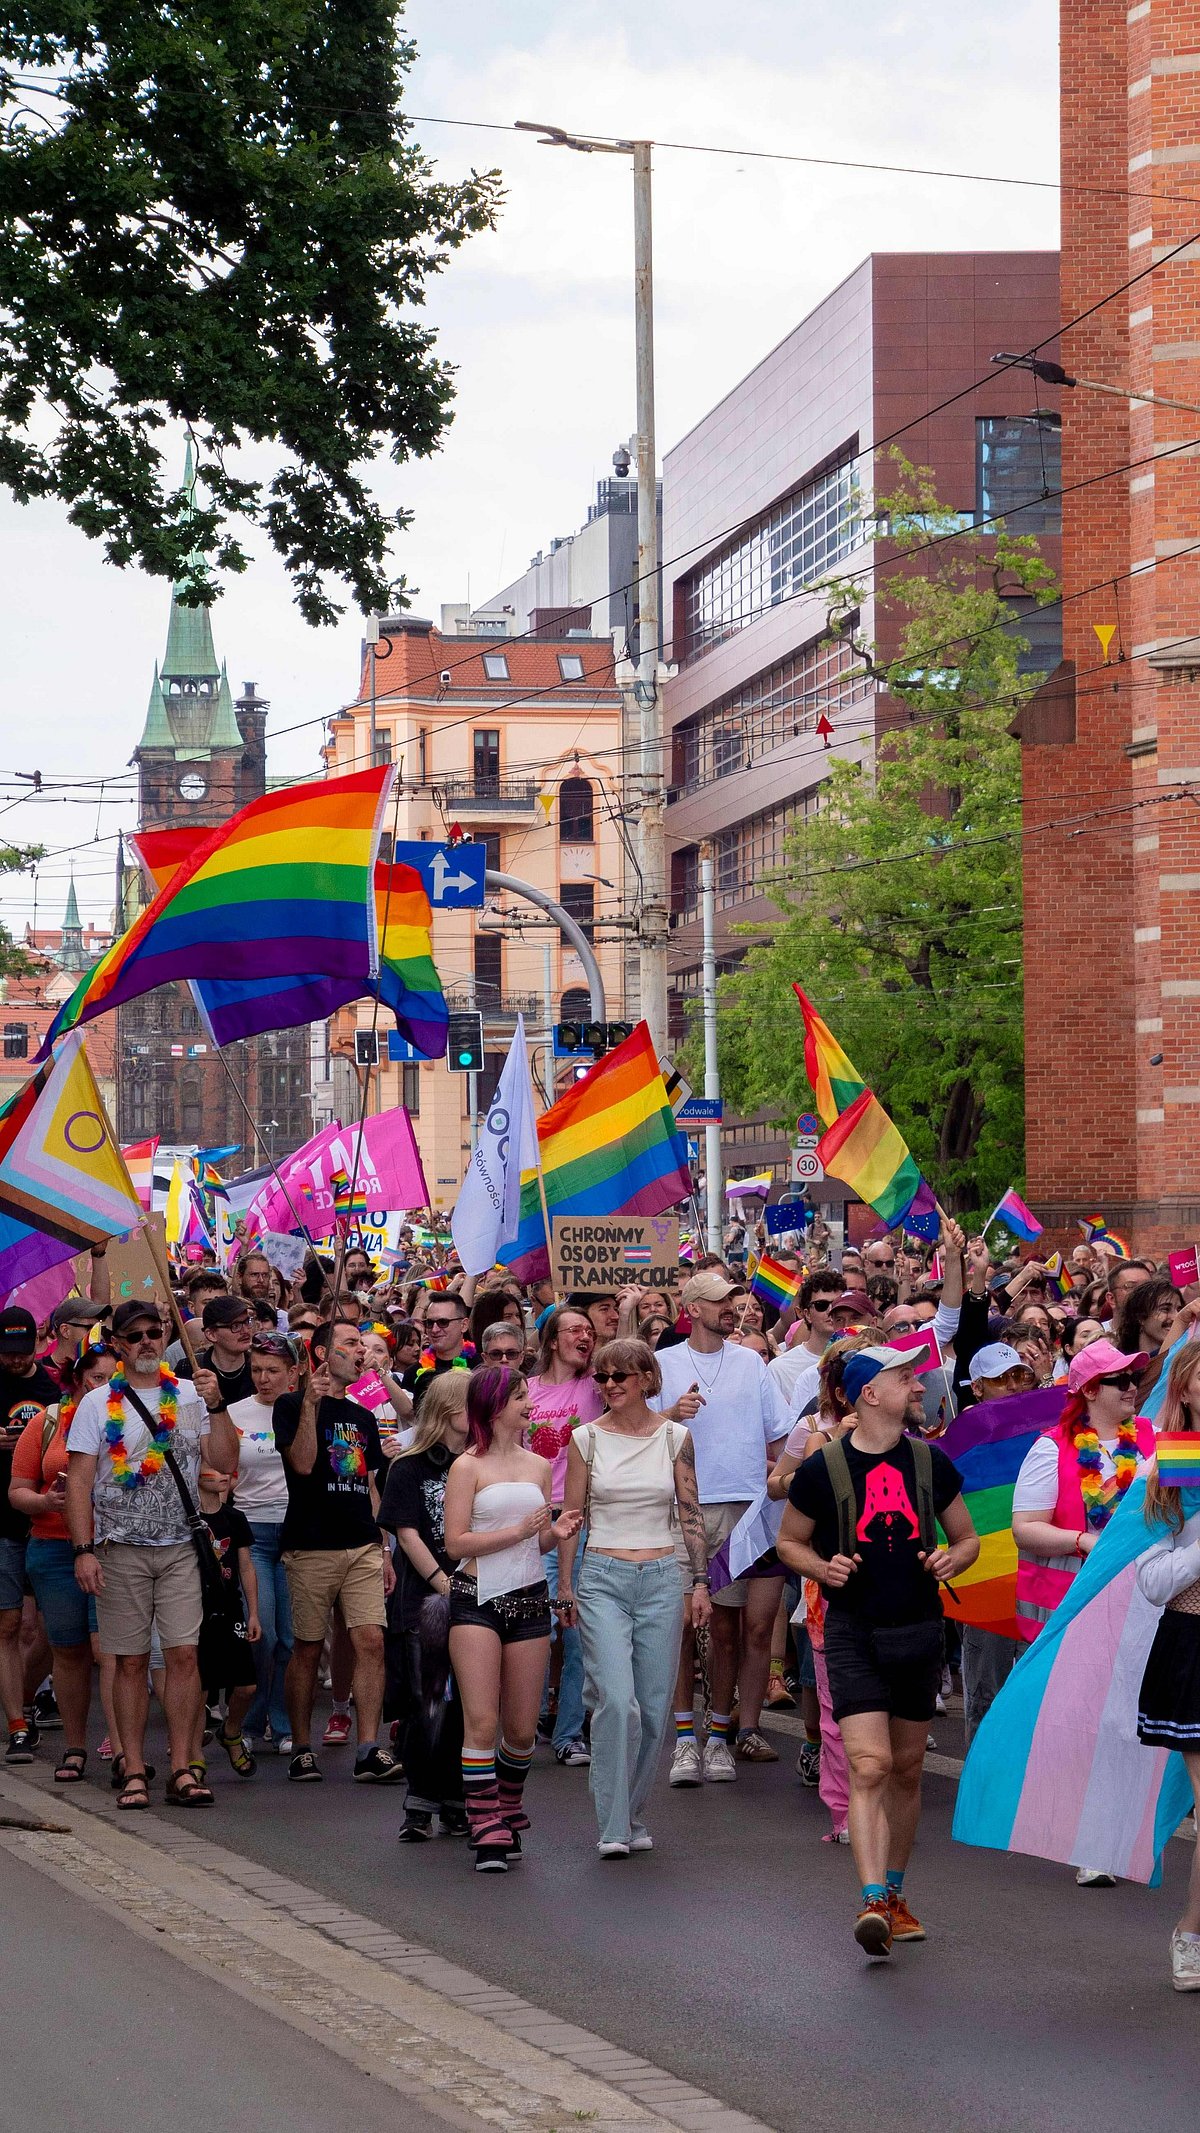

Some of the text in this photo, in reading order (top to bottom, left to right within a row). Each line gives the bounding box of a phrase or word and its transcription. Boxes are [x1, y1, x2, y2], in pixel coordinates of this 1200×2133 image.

[680, 1106, 714, 1116] Podwale
[801, 1160, 815, 1171] 30
[474, 1150, 501, 1210] Równości
[560, 1245, 621, 1262] OSOBY
[345, 1423, 358, 1432] THE
[327, 1483, 336, 1491] IN
[337, 1483, 351, 1491] THE
